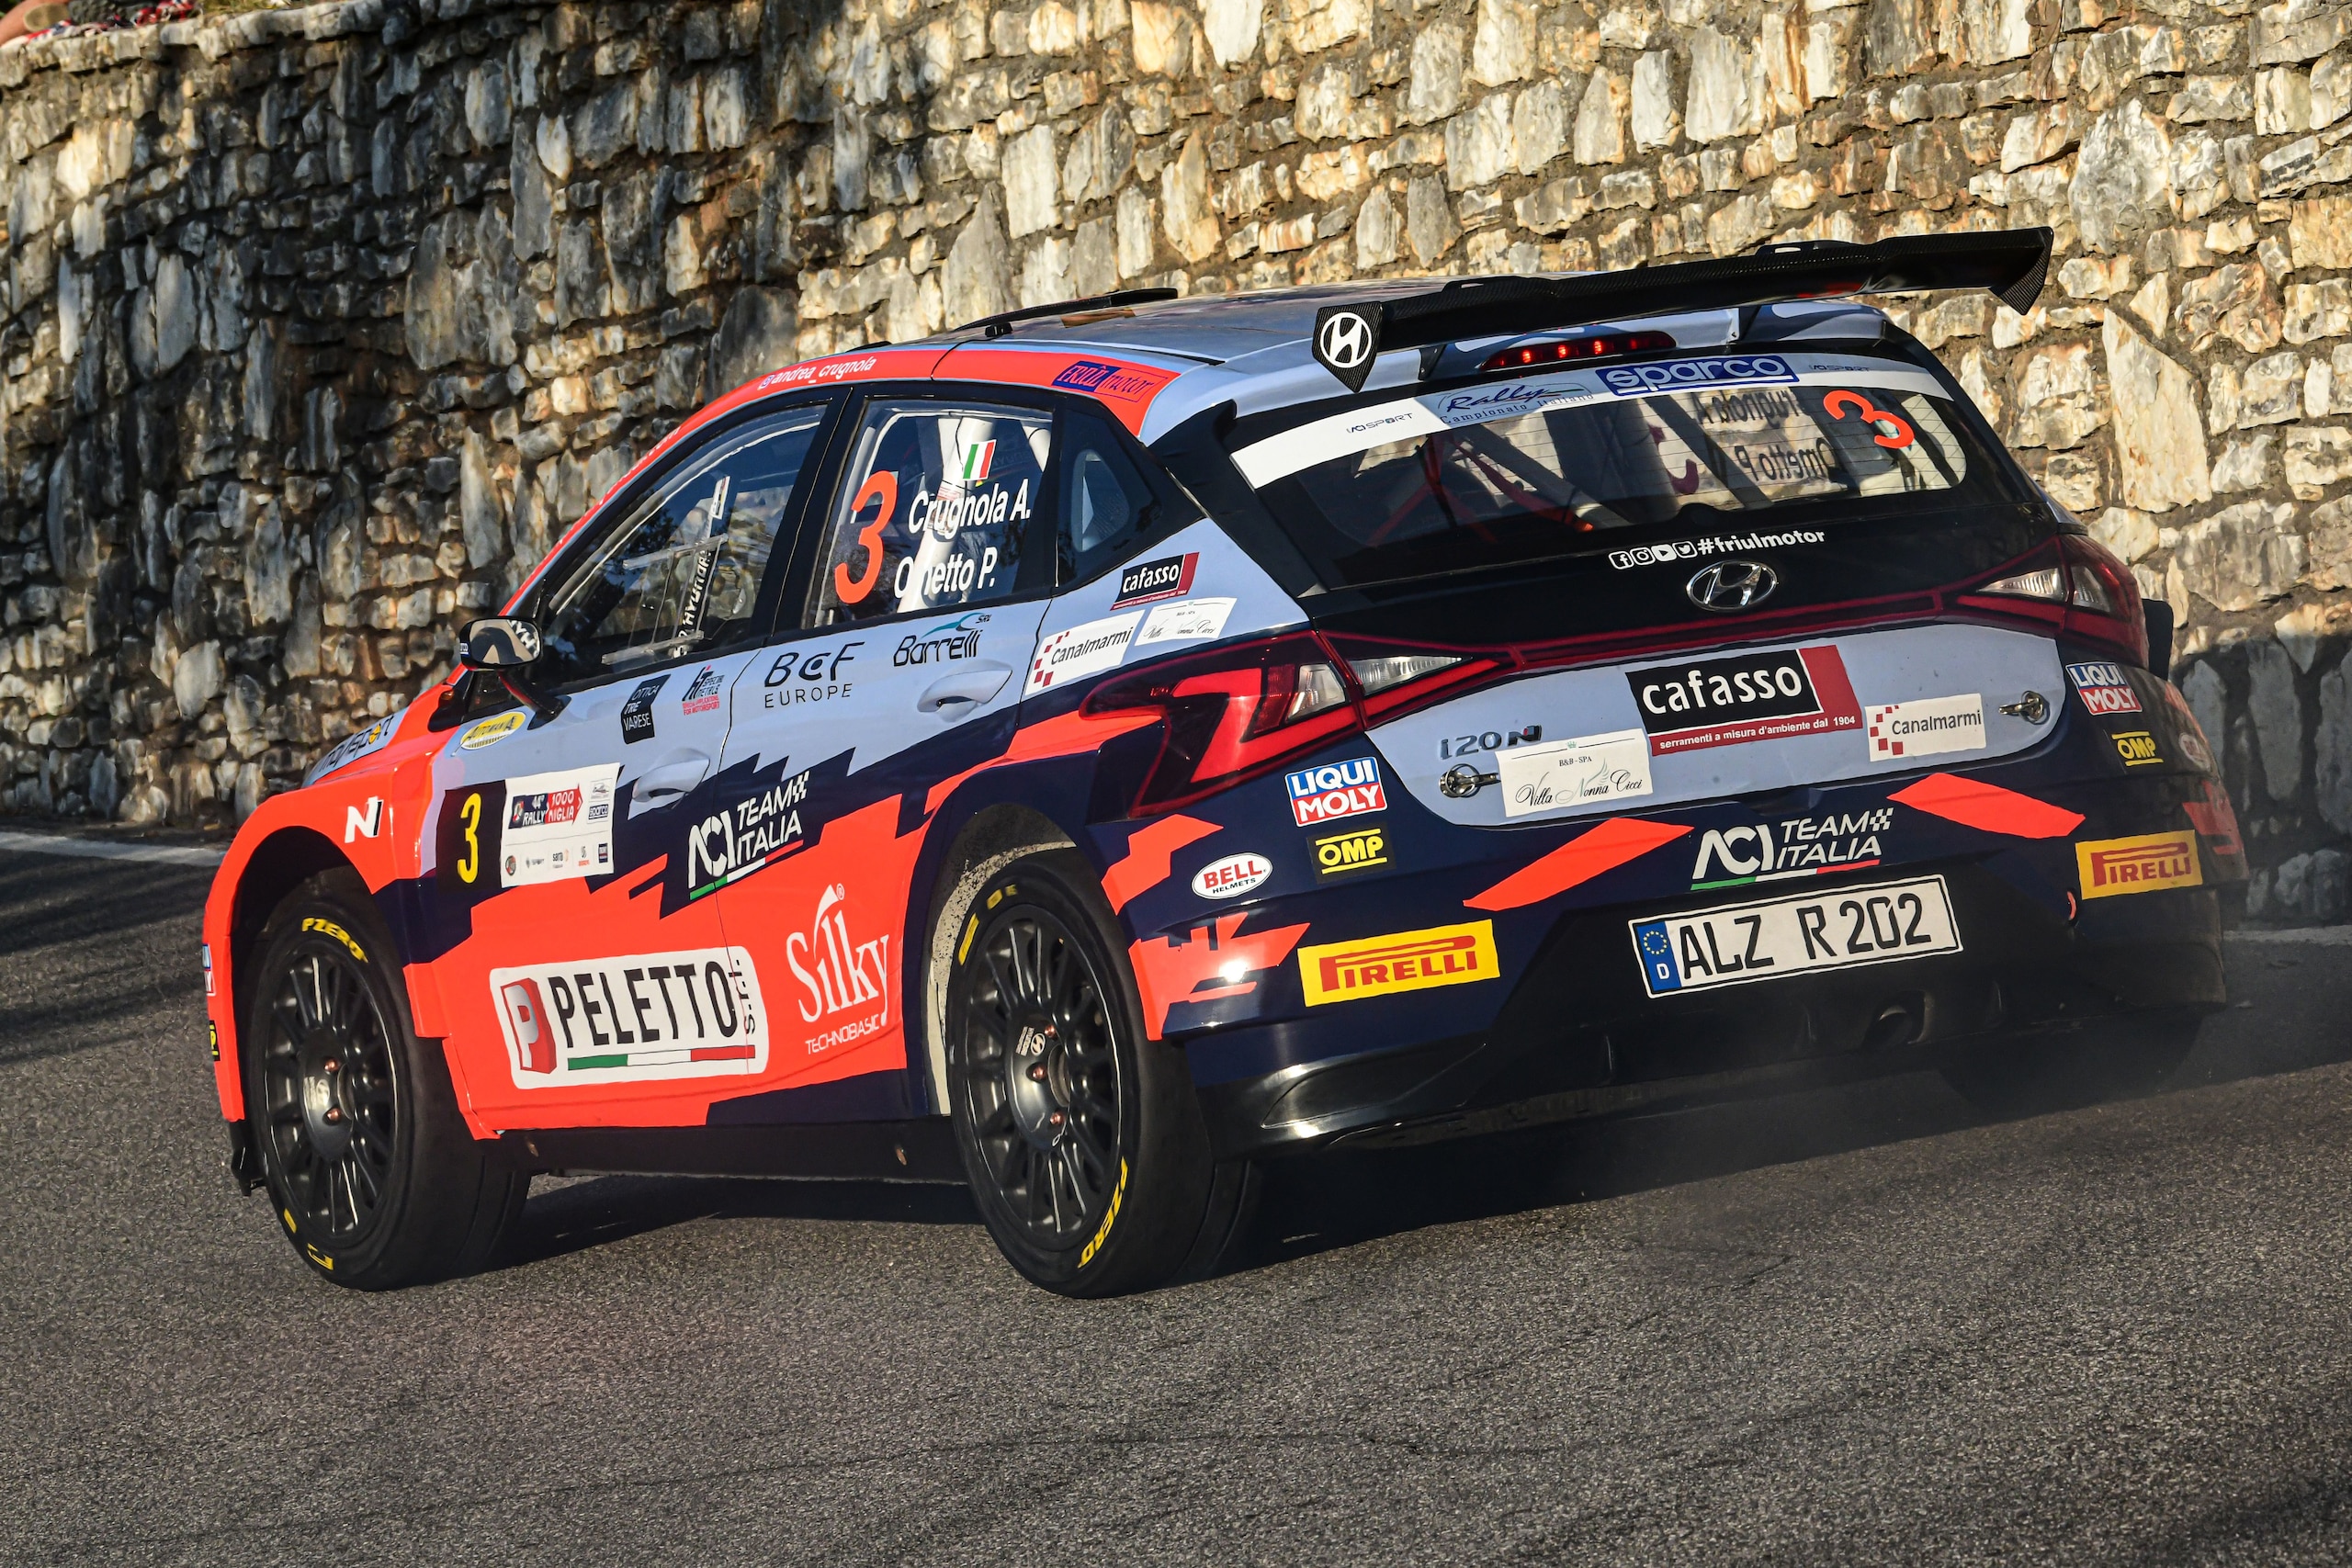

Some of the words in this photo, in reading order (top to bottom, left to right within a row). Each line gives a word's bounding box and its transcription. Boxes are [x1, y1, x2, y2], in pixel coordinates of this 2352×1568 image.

[1607, 356, 1785, 391] sparco
[1440, 403, 1527, 424] Campionato
[1536, 393, 1594, 409] Italiano
[1446, 384, 1550, 413] Rally
[1365, 412, 1413, 430] SPORT
[1824, 389, 1916, 449] 3
[908, 482, 1010, 540] Crugnola
[1009, 478, 1031, 522] A.
[834, 469, 899, 604] 3
[1697, 530, 1826, 556] #friulmotor
[976, 547, 998, 590] P.
[1122, 564, 1180, 593] cafasso
[893, 629, 983, 668] Barrelli
[1050, 626, 1134, 666] Canalmarmi
[631, 684, 661, 701] OTTICA
[1641, 665, 1803, 716] cafasso
[2069, 663, 2127, 687] LIQUI
[624, 701, 642, 715] TRE
[764, 682, 853, 709] EUROPE
[2084, 687, 2140, 712] MOLY
[623, 712, 651, 732] VARESE
[1659, 733, 1713, 750] serramenti
[1714, 733, 1721, 742] a
[1723, 727, 1757, 741] misura
[1758, 720, 1811, 738] d'ambiente
[1813, 717, 1829, 729] dal
[1833, 716, 1856, 727] 1904
[1891, 709, 1983, 737] Canalmarmi
[1559, 758, 1575, 768] B&B
[1578, 756, 1593, 765] SPA
[2117, 737, 2157, 760] OMP
[1290, 759, 1376, 798] LIQUI
[1515, 771, 1553, 807] Villa
[1611, 769, 1643, 793] Cicci
[551, 790, 575, 807] 1000
[737, 788, 794, 831] TEAM
[1296, 784, 1380, 823] MOLY
[522, 810, 546, 827] RALLY
[736, 808, 803, 863] ITALIA
[1780, 809, 1871, 844] TEAM
[457, 792, 482, 885] 3
[688, 809, 737, 889] ACI
[1317, 835, 1385, 866] OMP
[1691, 823, 1775, 881] ACI
[1776, 834, 1883, 870] ITALIA
[1203, 860, 1263, 890] BELL
[2090, 841, 2193, 888] PIRELLI
[1212, 877, 1257, 895] HELMETS
[786, 884, 889, 1028] Silky
[1318, 934, 1478, 993] PIRELLI
[1679, 914, 1775, 980] ALZ
[1657, 963, 1670, 980] D
[548, 960, 739, 1049] PELETTO
[805, 1012, 880, 1056] TECHNOBASIC
